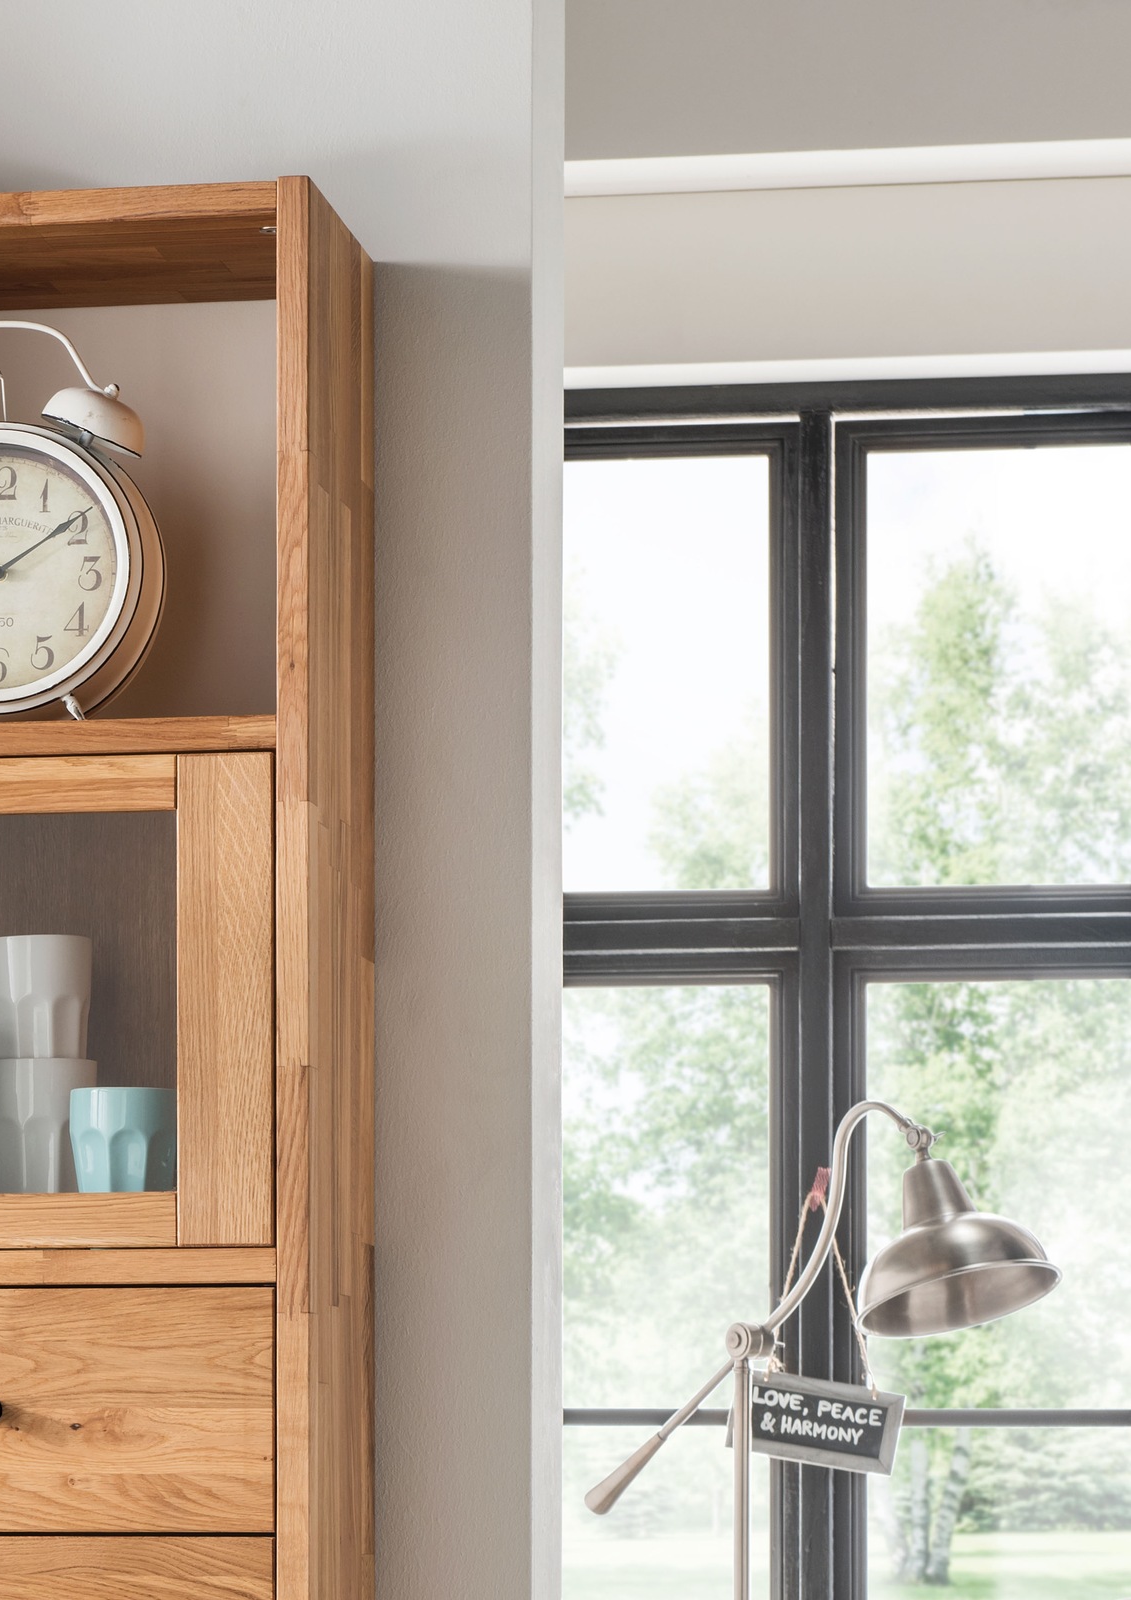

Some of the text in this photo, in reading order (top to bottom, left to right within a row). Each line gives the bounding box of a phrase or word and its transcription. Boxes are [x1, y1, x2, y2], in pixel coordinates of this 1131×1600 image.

[39, 478, 51, 513] 1
[67, 510, 89, 546] 2
[78, 556, 102, 591] 3
[63, 601, 90, 637] 4
[30, 635, 55, 670] 5
[752, 1385, 883, 1427] LOVE, PEACE
[760, 1411, 864, 1446] & HARMONY
